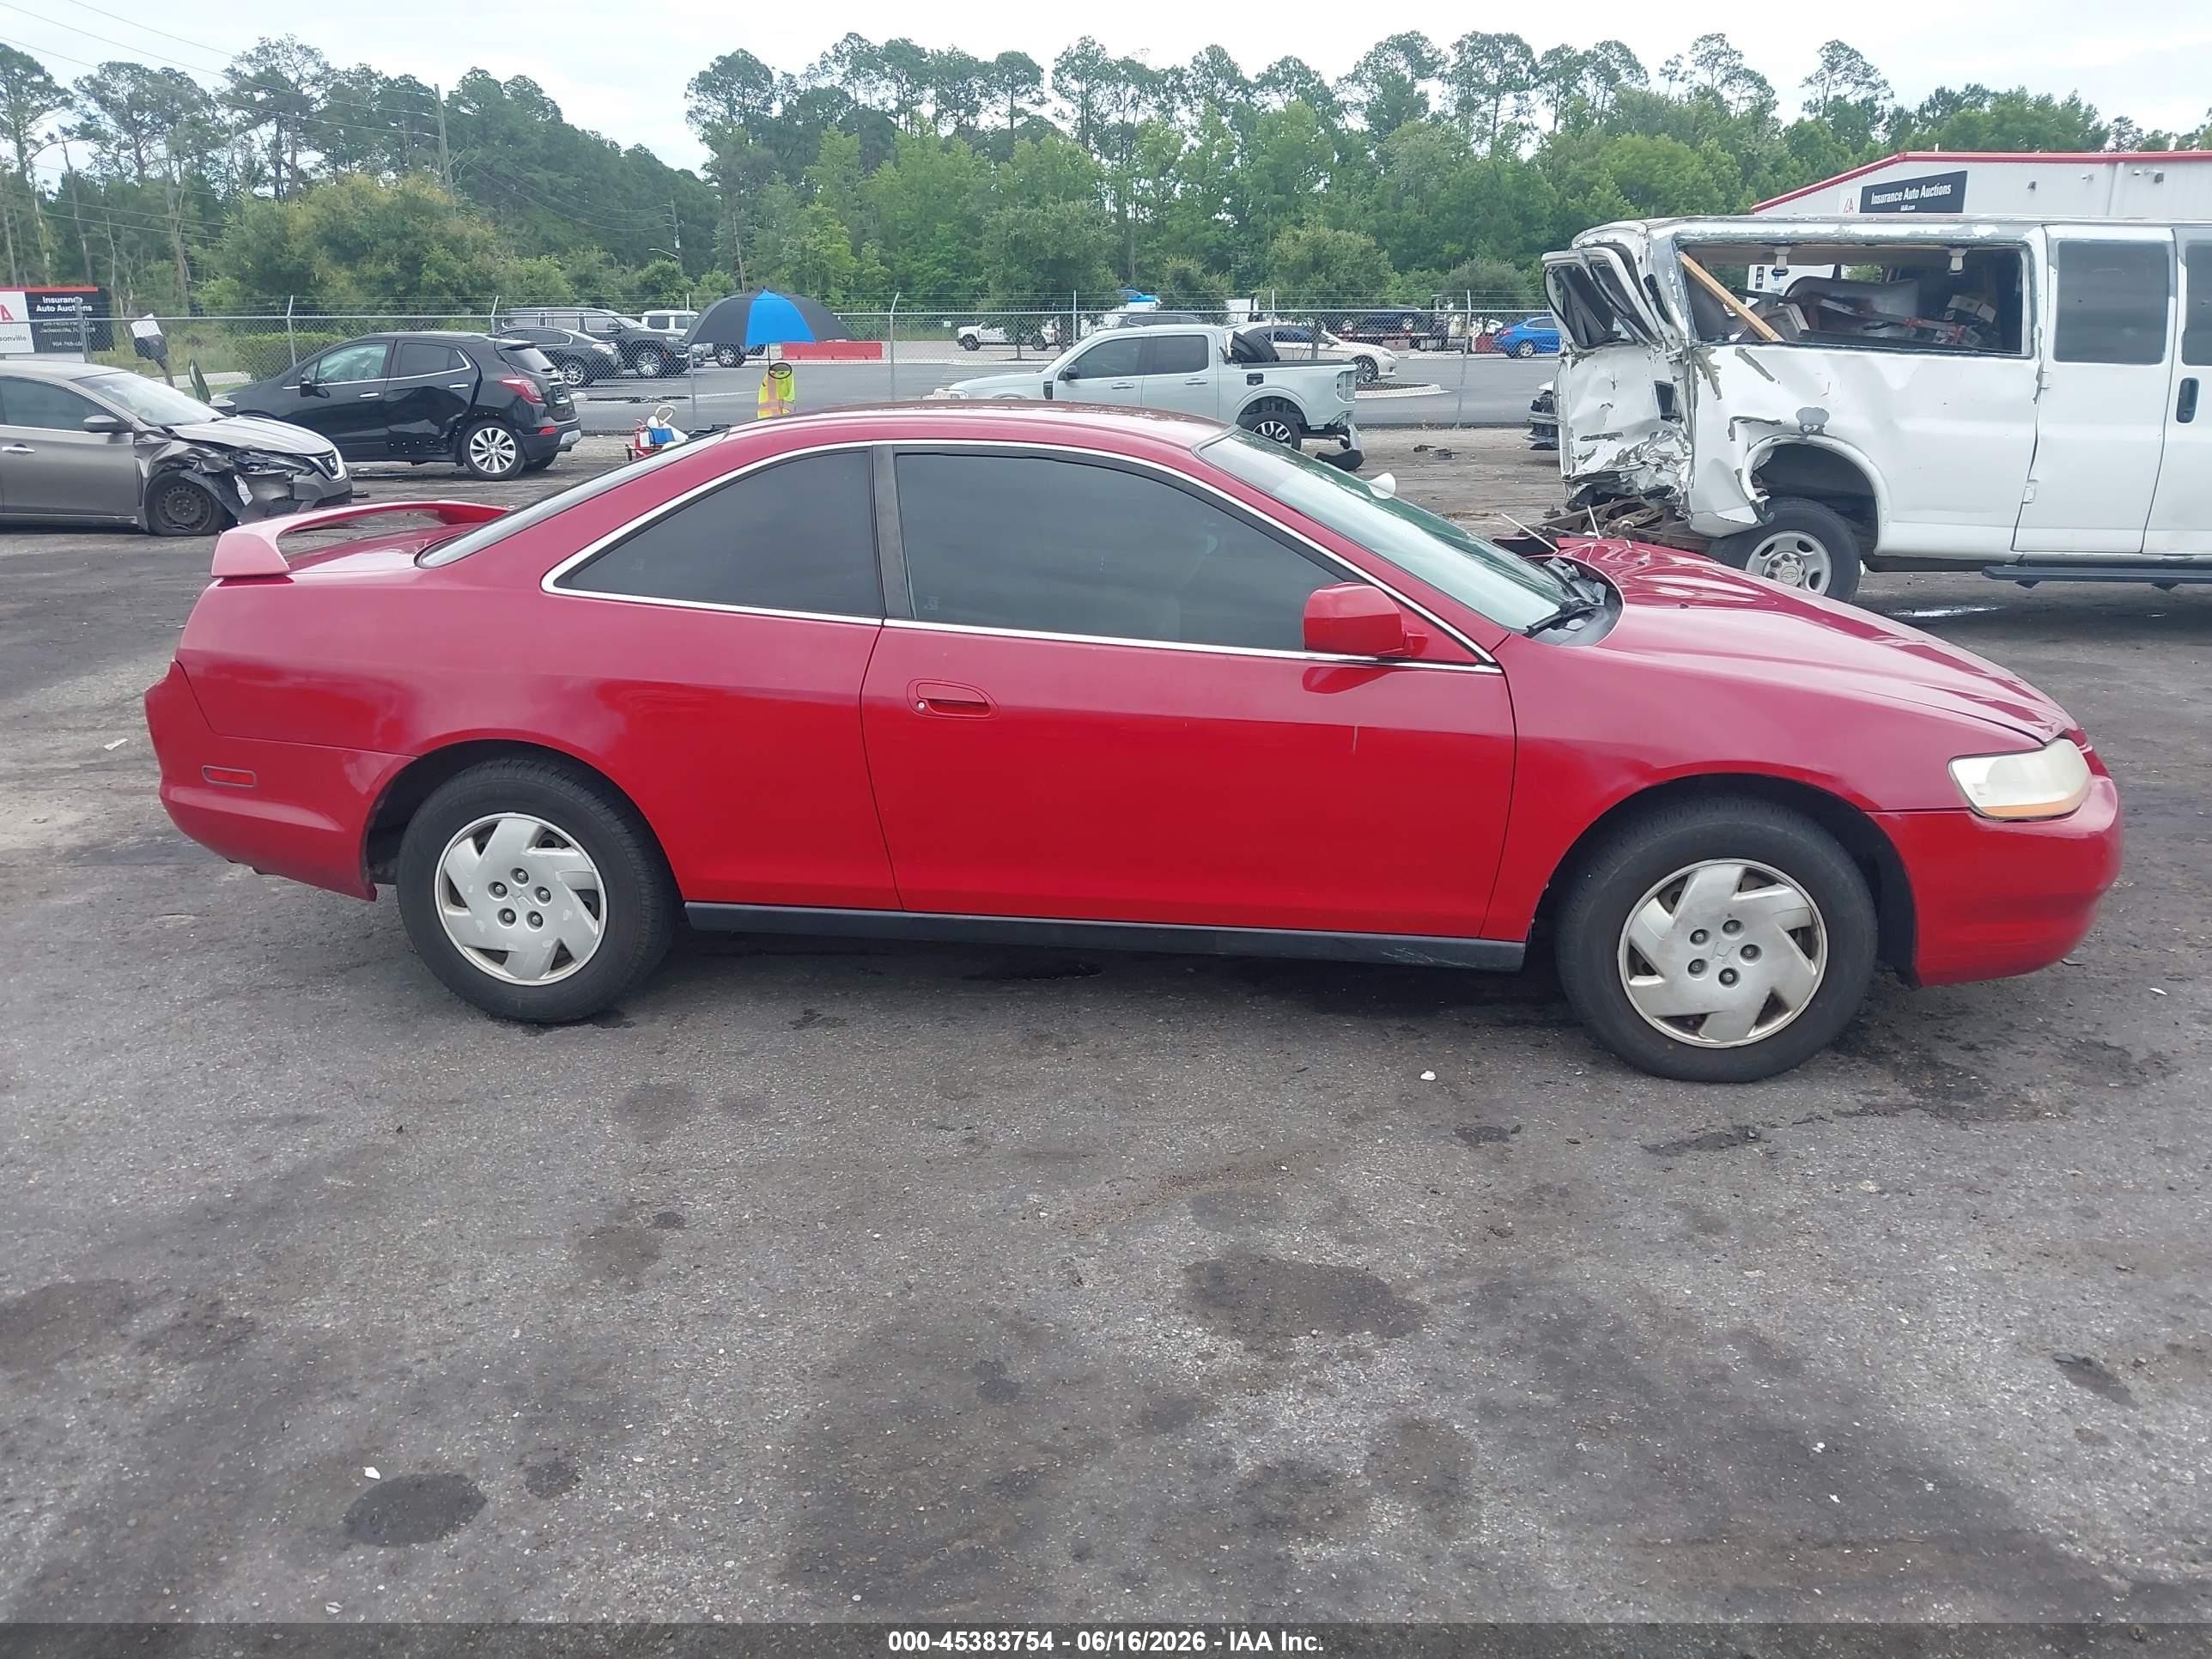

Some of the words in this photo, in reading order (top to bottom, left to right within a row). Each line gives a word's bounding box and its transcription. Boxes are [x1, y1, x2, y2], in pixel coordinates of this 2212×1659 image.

[1871, 191, 1903, 204] Insurance
[1903, 186, 1920, 201] Auto
[1920, 182, 1952, 198] Auctions
